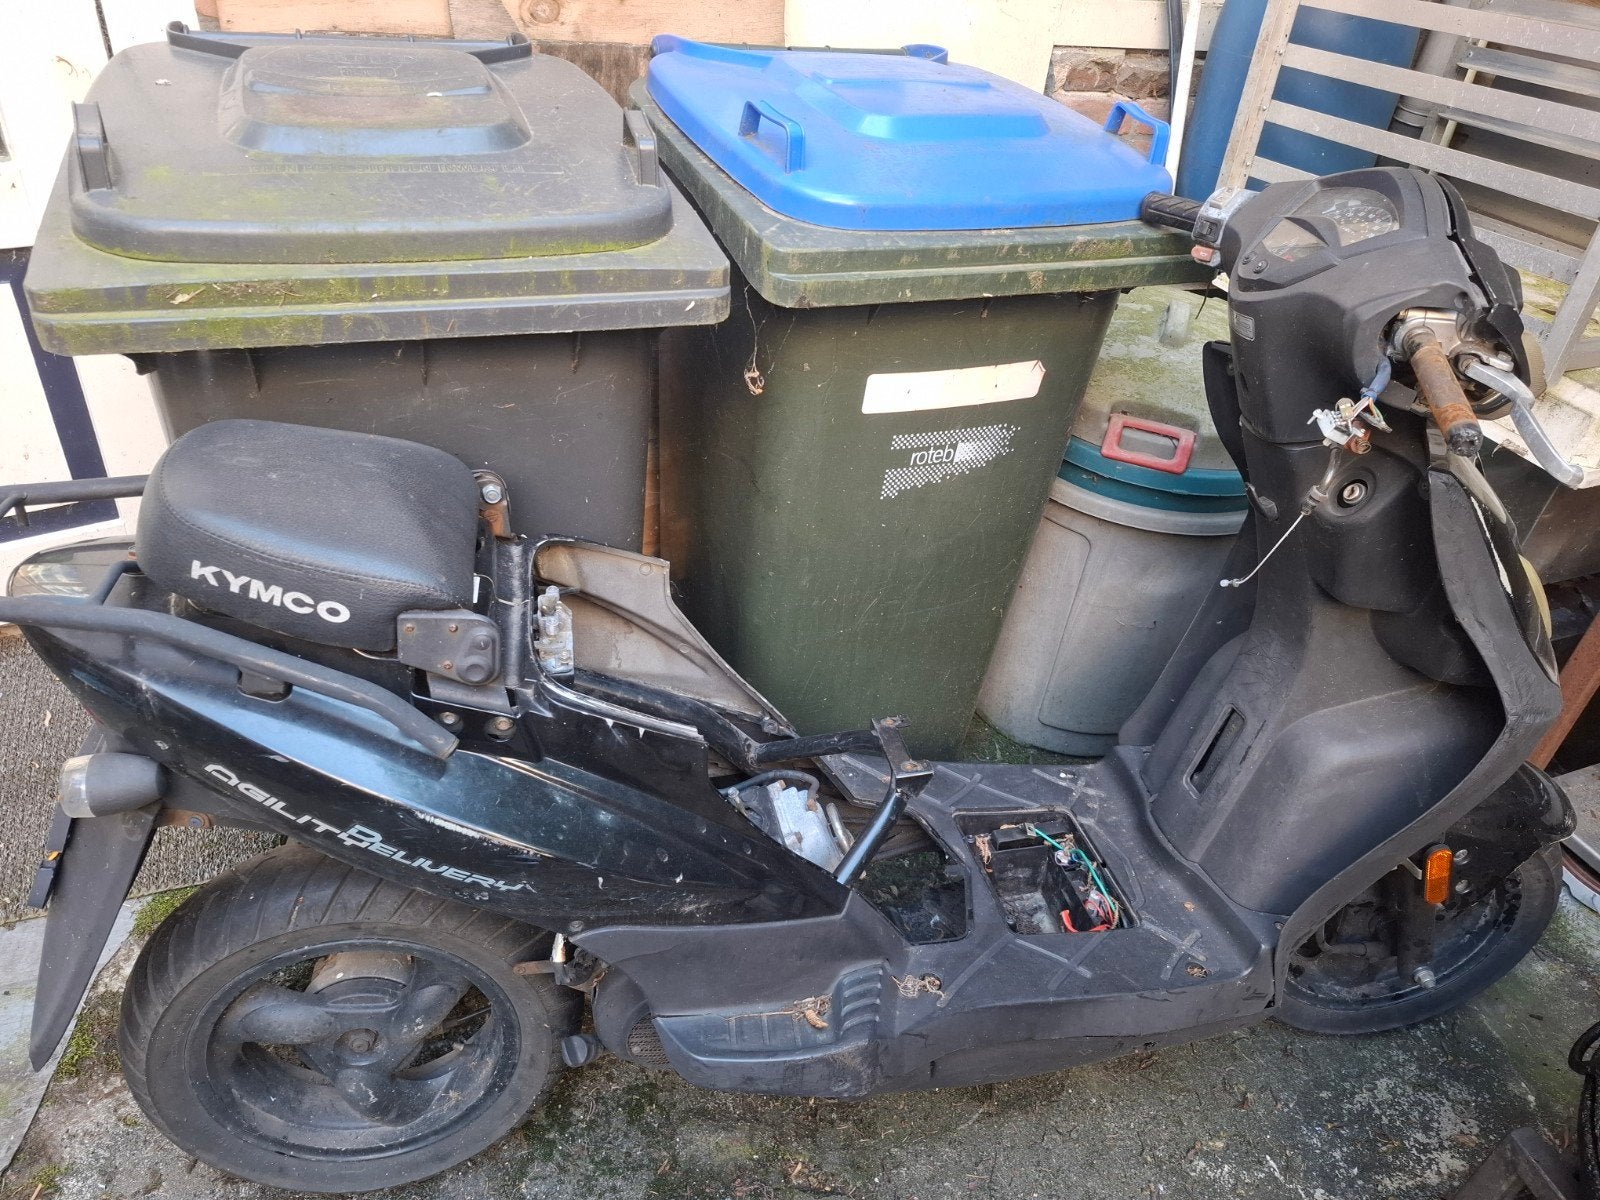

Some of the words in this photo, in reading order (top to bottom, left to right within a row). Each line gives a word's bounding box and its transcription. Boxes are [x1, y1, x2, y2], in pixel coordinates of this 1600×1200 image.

[910, 445, 954, 466] roteb
[191, 559, 351, 623] KYMCO
[345, 824, 524, 891] DELIVERY
